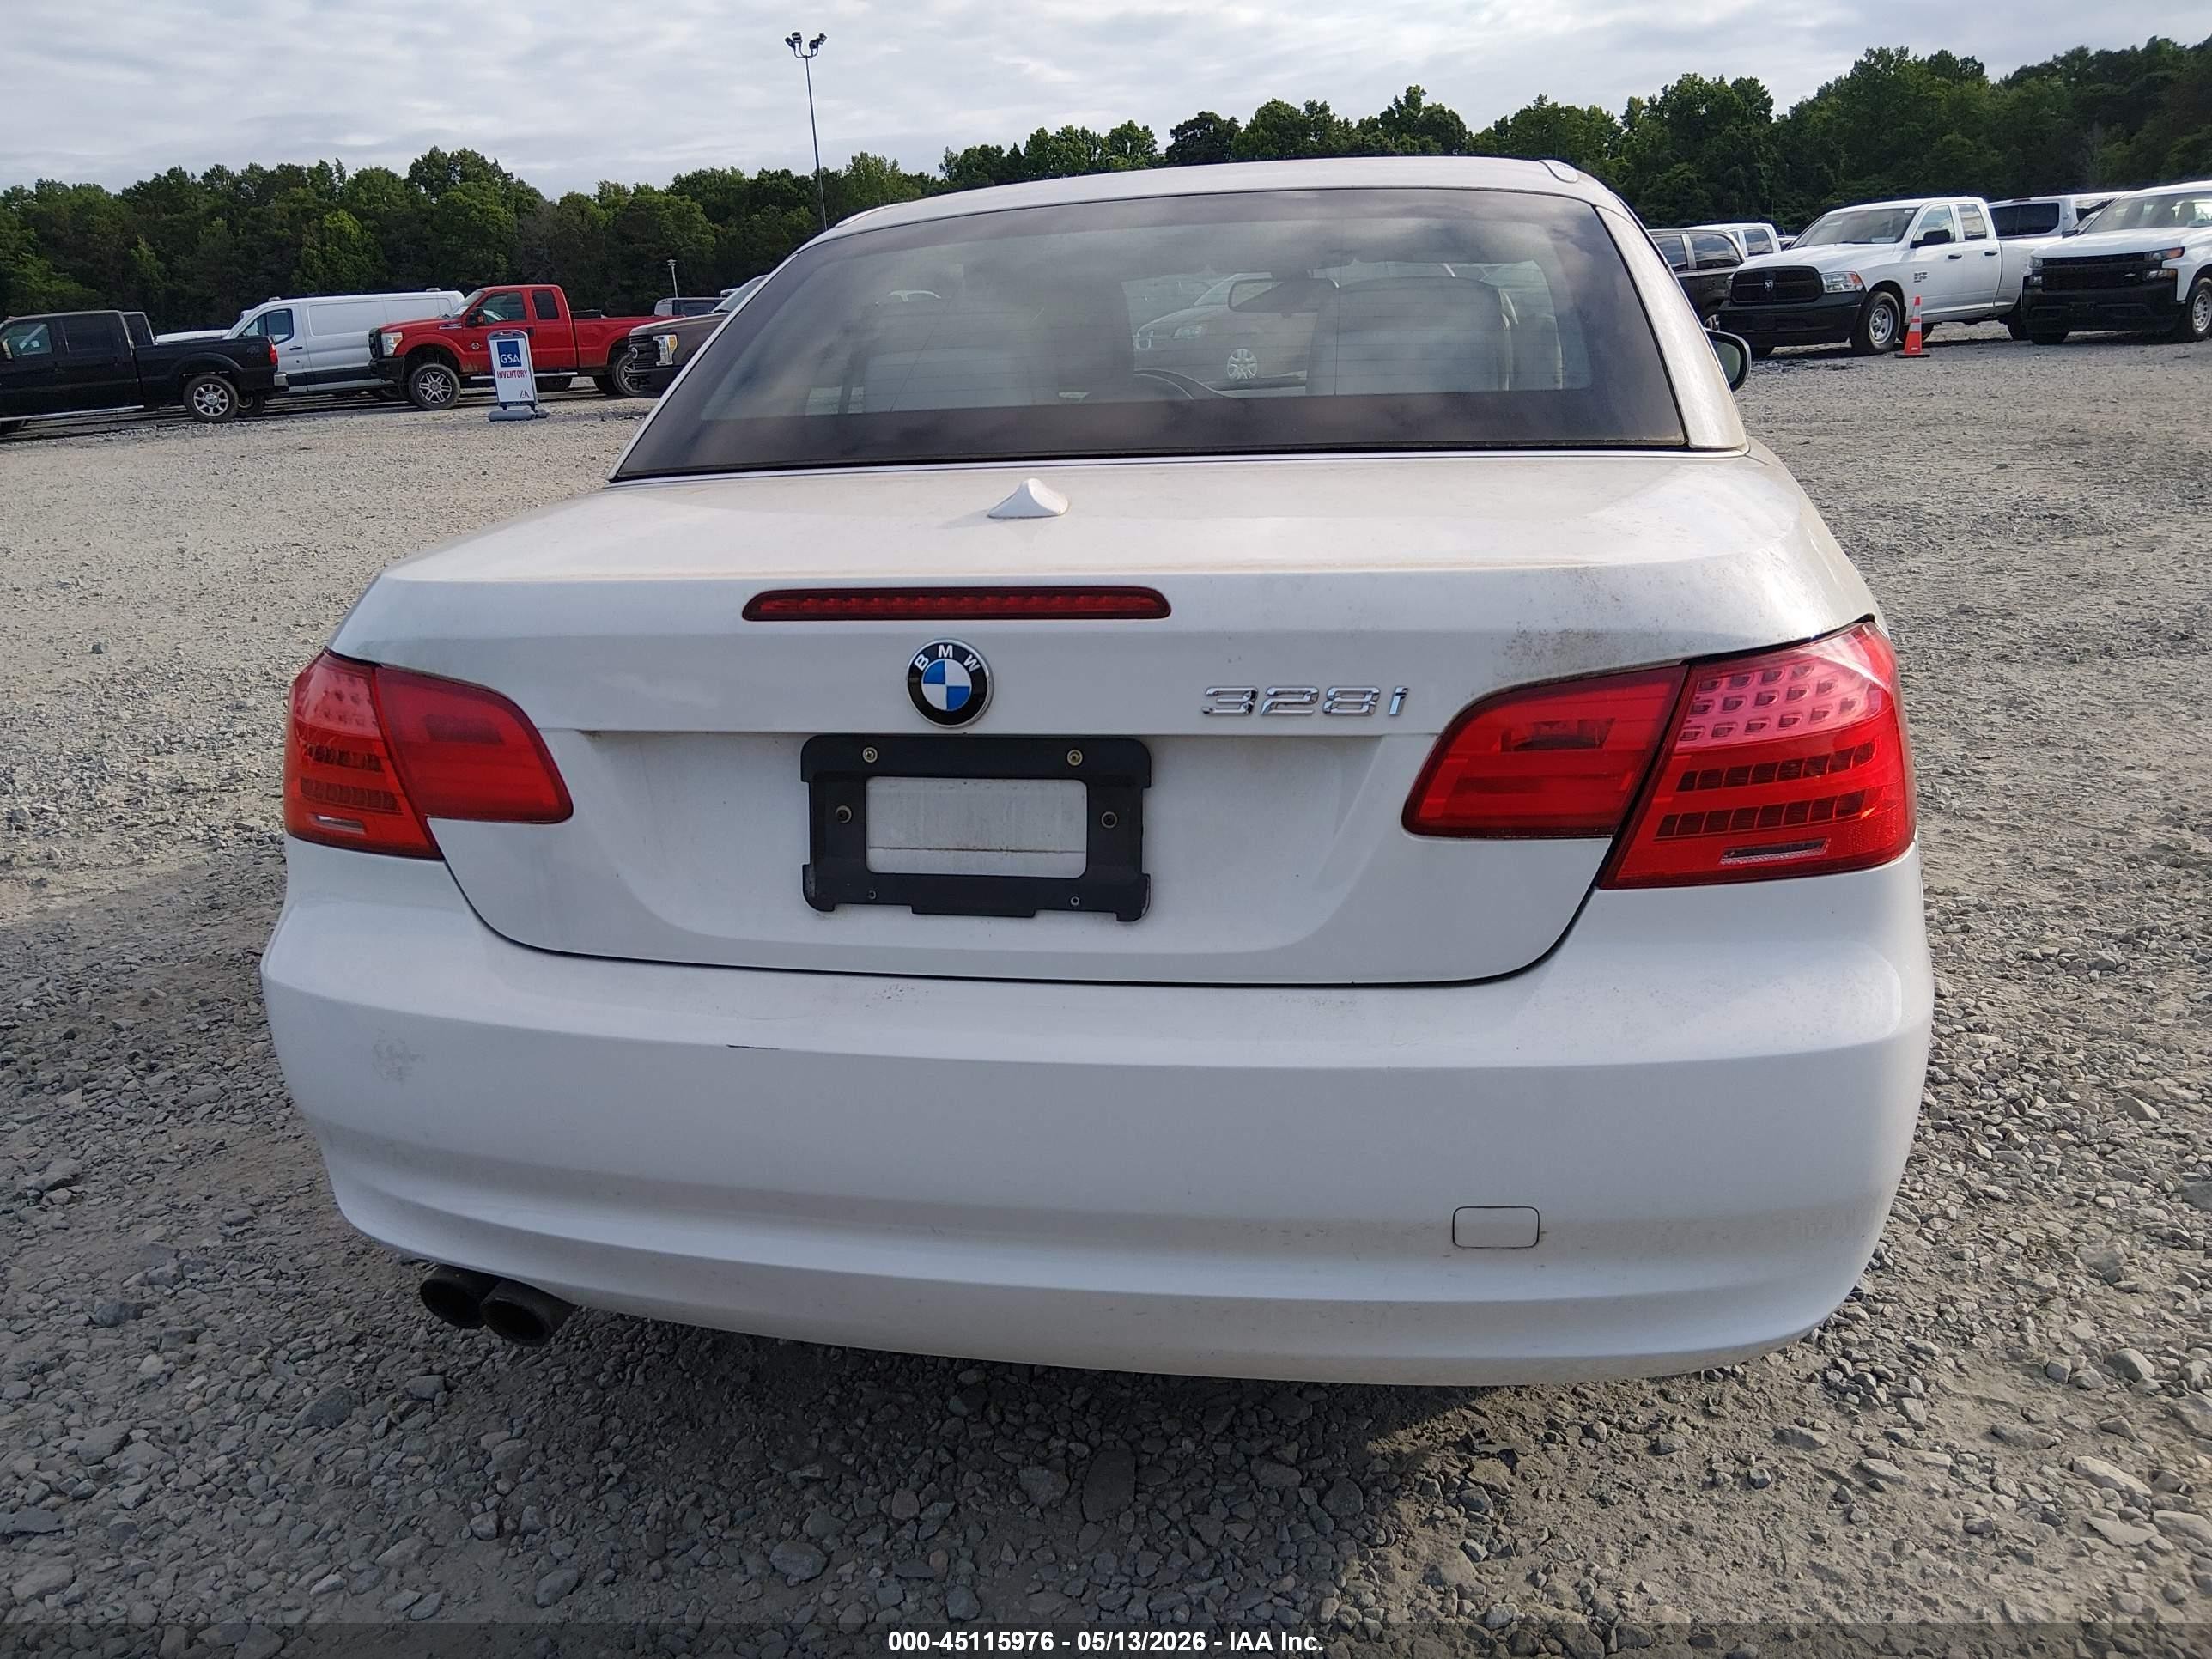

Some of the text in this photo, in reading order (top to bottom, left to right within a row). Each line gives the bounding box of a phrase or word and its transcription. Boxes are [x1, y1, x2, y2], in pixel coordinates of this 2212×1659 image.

[500, 353, 520, 364] GSA
[496, 369, 528, 379] INVENTORY
[914, 644, 981, 673] BMW
[1201, 686, 1409, 715] 328i
